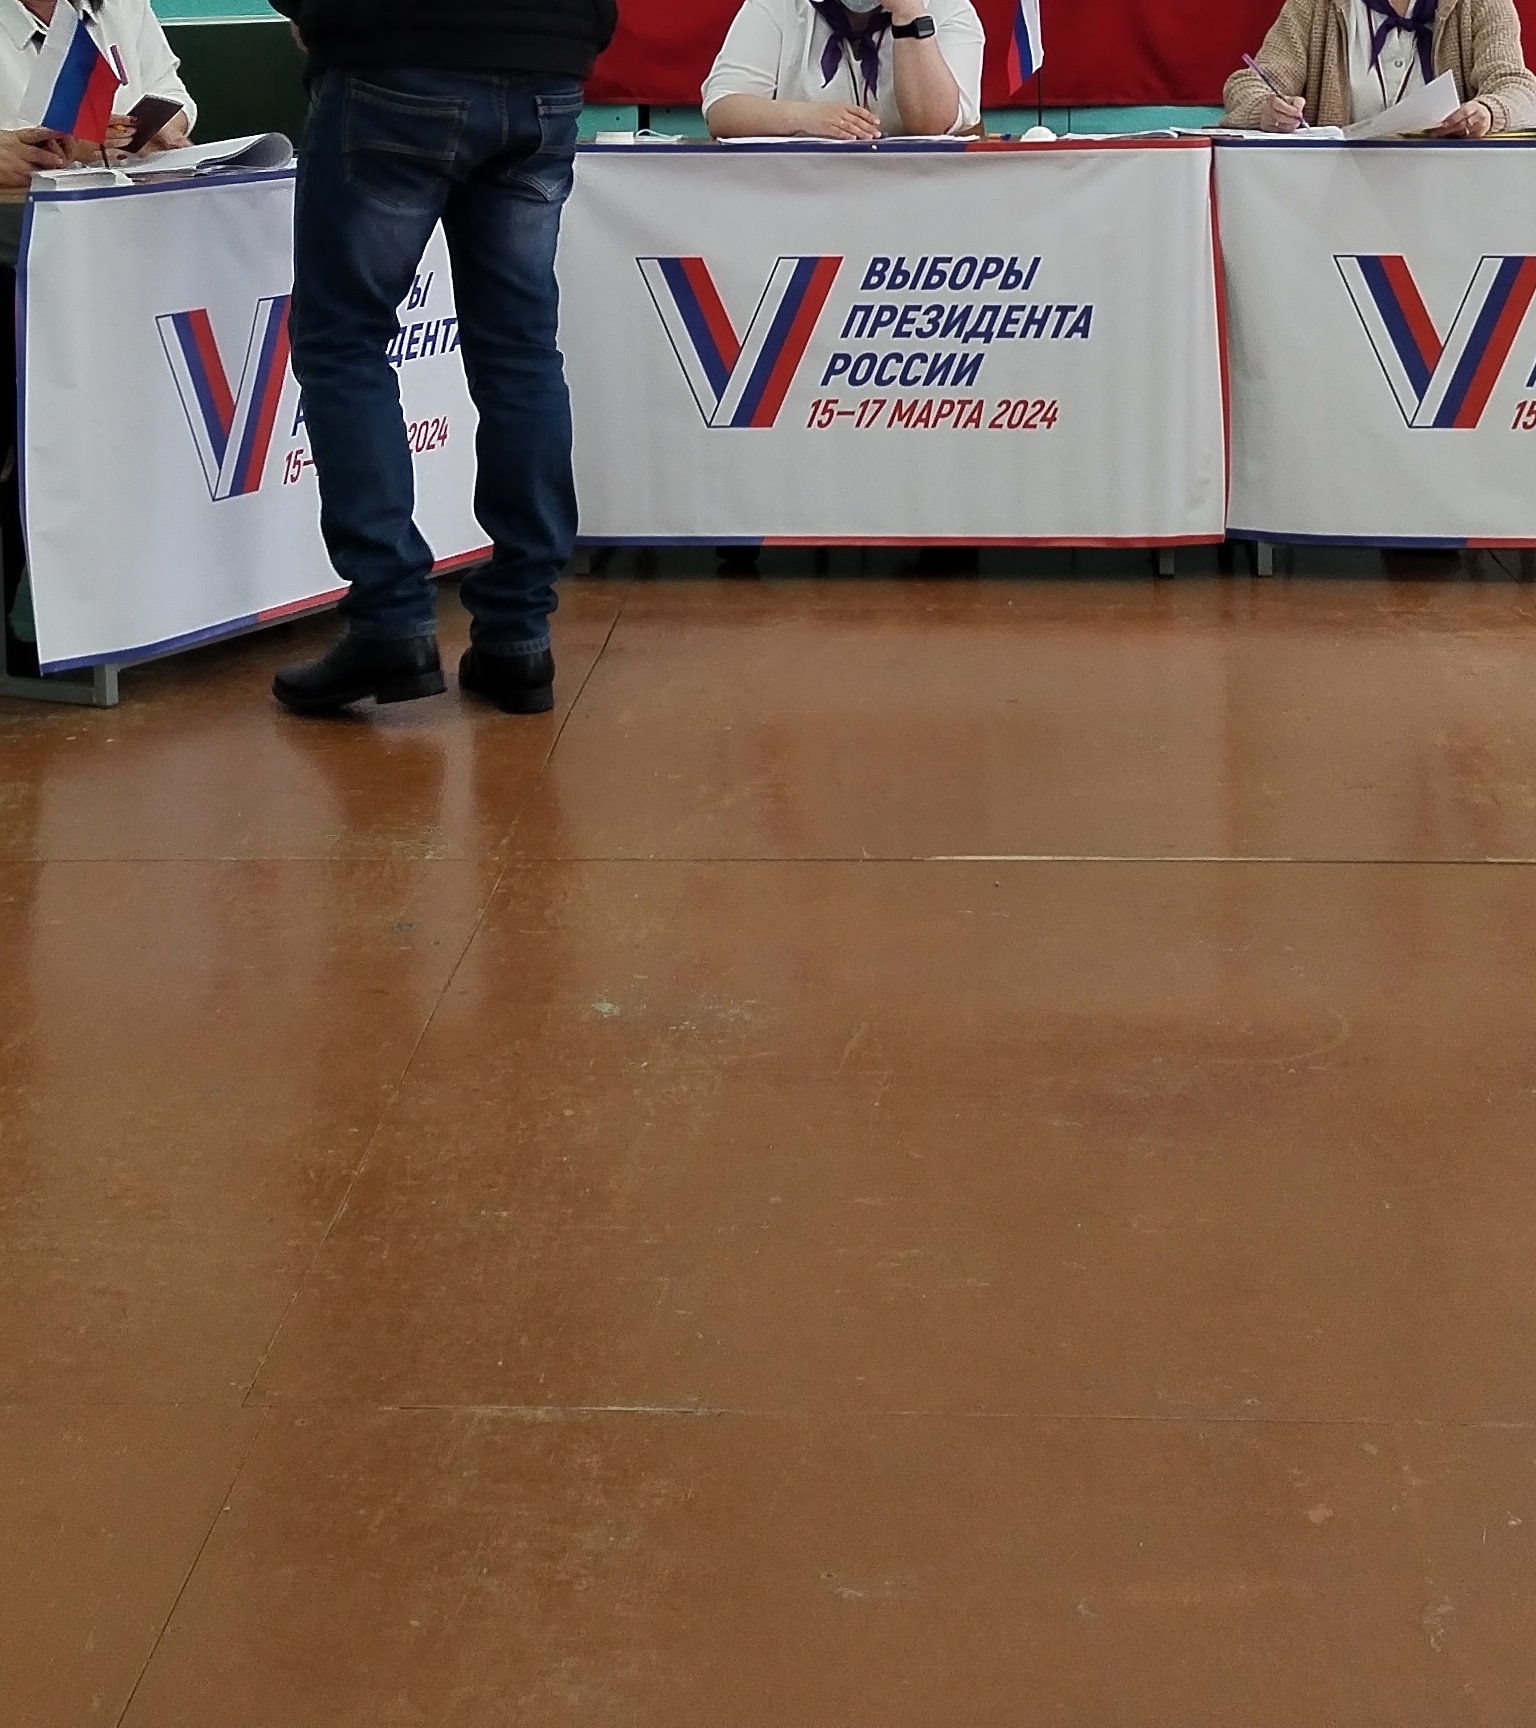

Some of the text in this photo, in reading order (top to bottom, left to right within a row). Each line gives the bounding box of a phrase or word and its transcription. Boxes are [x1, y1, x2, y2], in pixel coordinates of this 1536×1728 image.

[860, 255, 1041, 291] ВЫБОРЫ
[840, 303, 1092, 345] ПРЕЗИДЕНТА
[820, 351, 984, 387] РОССИИ
[887, 399, 983, 429] МАРТА
[987, 399, 1059, 429] 2024
